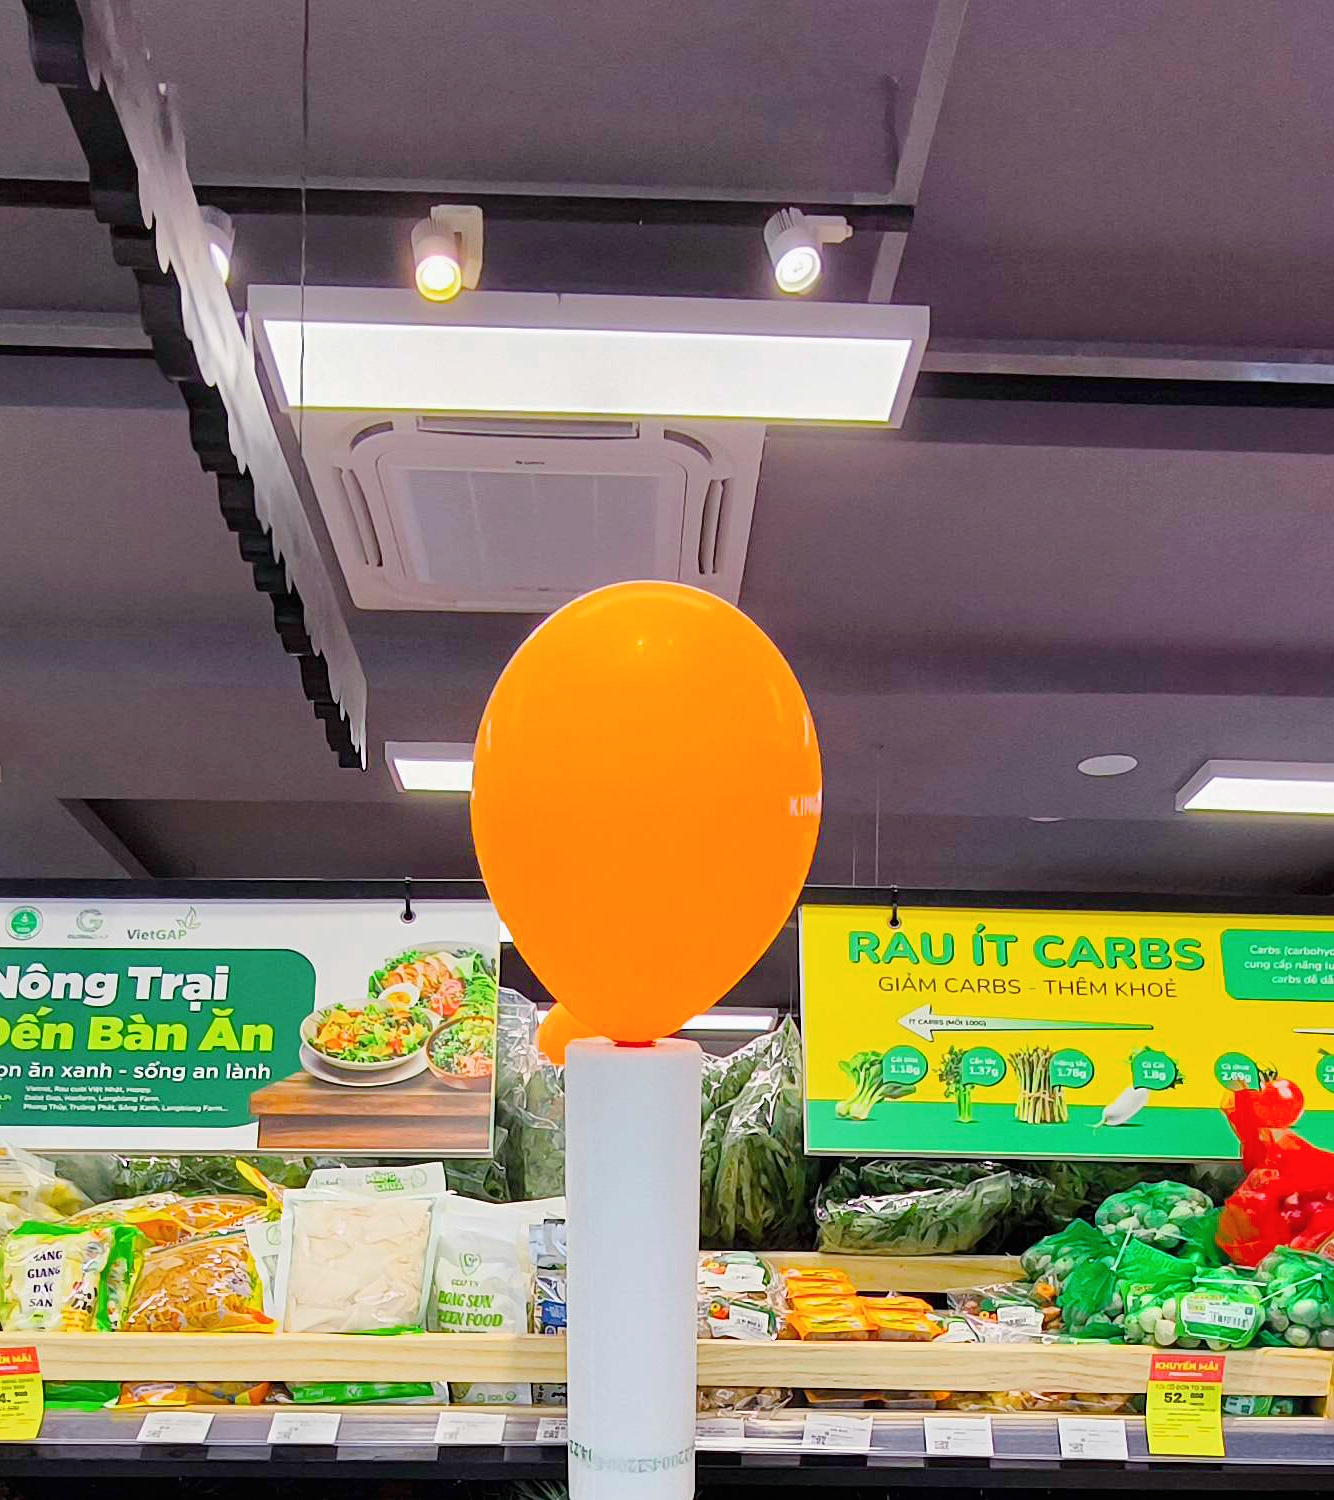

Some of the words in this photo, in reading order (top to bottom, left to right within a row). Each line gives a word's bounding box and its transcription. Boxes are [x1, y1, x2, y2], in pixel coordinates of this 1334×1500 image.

[127, 928, 187, 941] VietGAP
[847, 930, 955, 965] RAU
[973, 923, 1018, 967] ÍT
[1033, 935, 1205, 971] CARBS
[128, 965, 230, 1012] Trại
[878, 972, 937, 993] GIẢM
[944, 977, 1021, 994] CARBS
[1043, 975, 1107, 996] THÊM
[87, 1014, 188, 1052] Bàn
[197, 1008, 274, 1052] Ăn
[28, 1064, 53, 1078] ăn
[62, 1062, 112, 1078] xanh
[133, 1060, 185, 1083] sống
[192, 1065, 218, 1079] an
[225, 1062, 271, 1079] lành
[890, 1064, 921, 1076] 1.18g
[969, 1065, 999, 1078] 1.37g
[466, 1312, 503, 1328] FOOD
[1155, 1360, 1197, 1371] KHUYẾN
